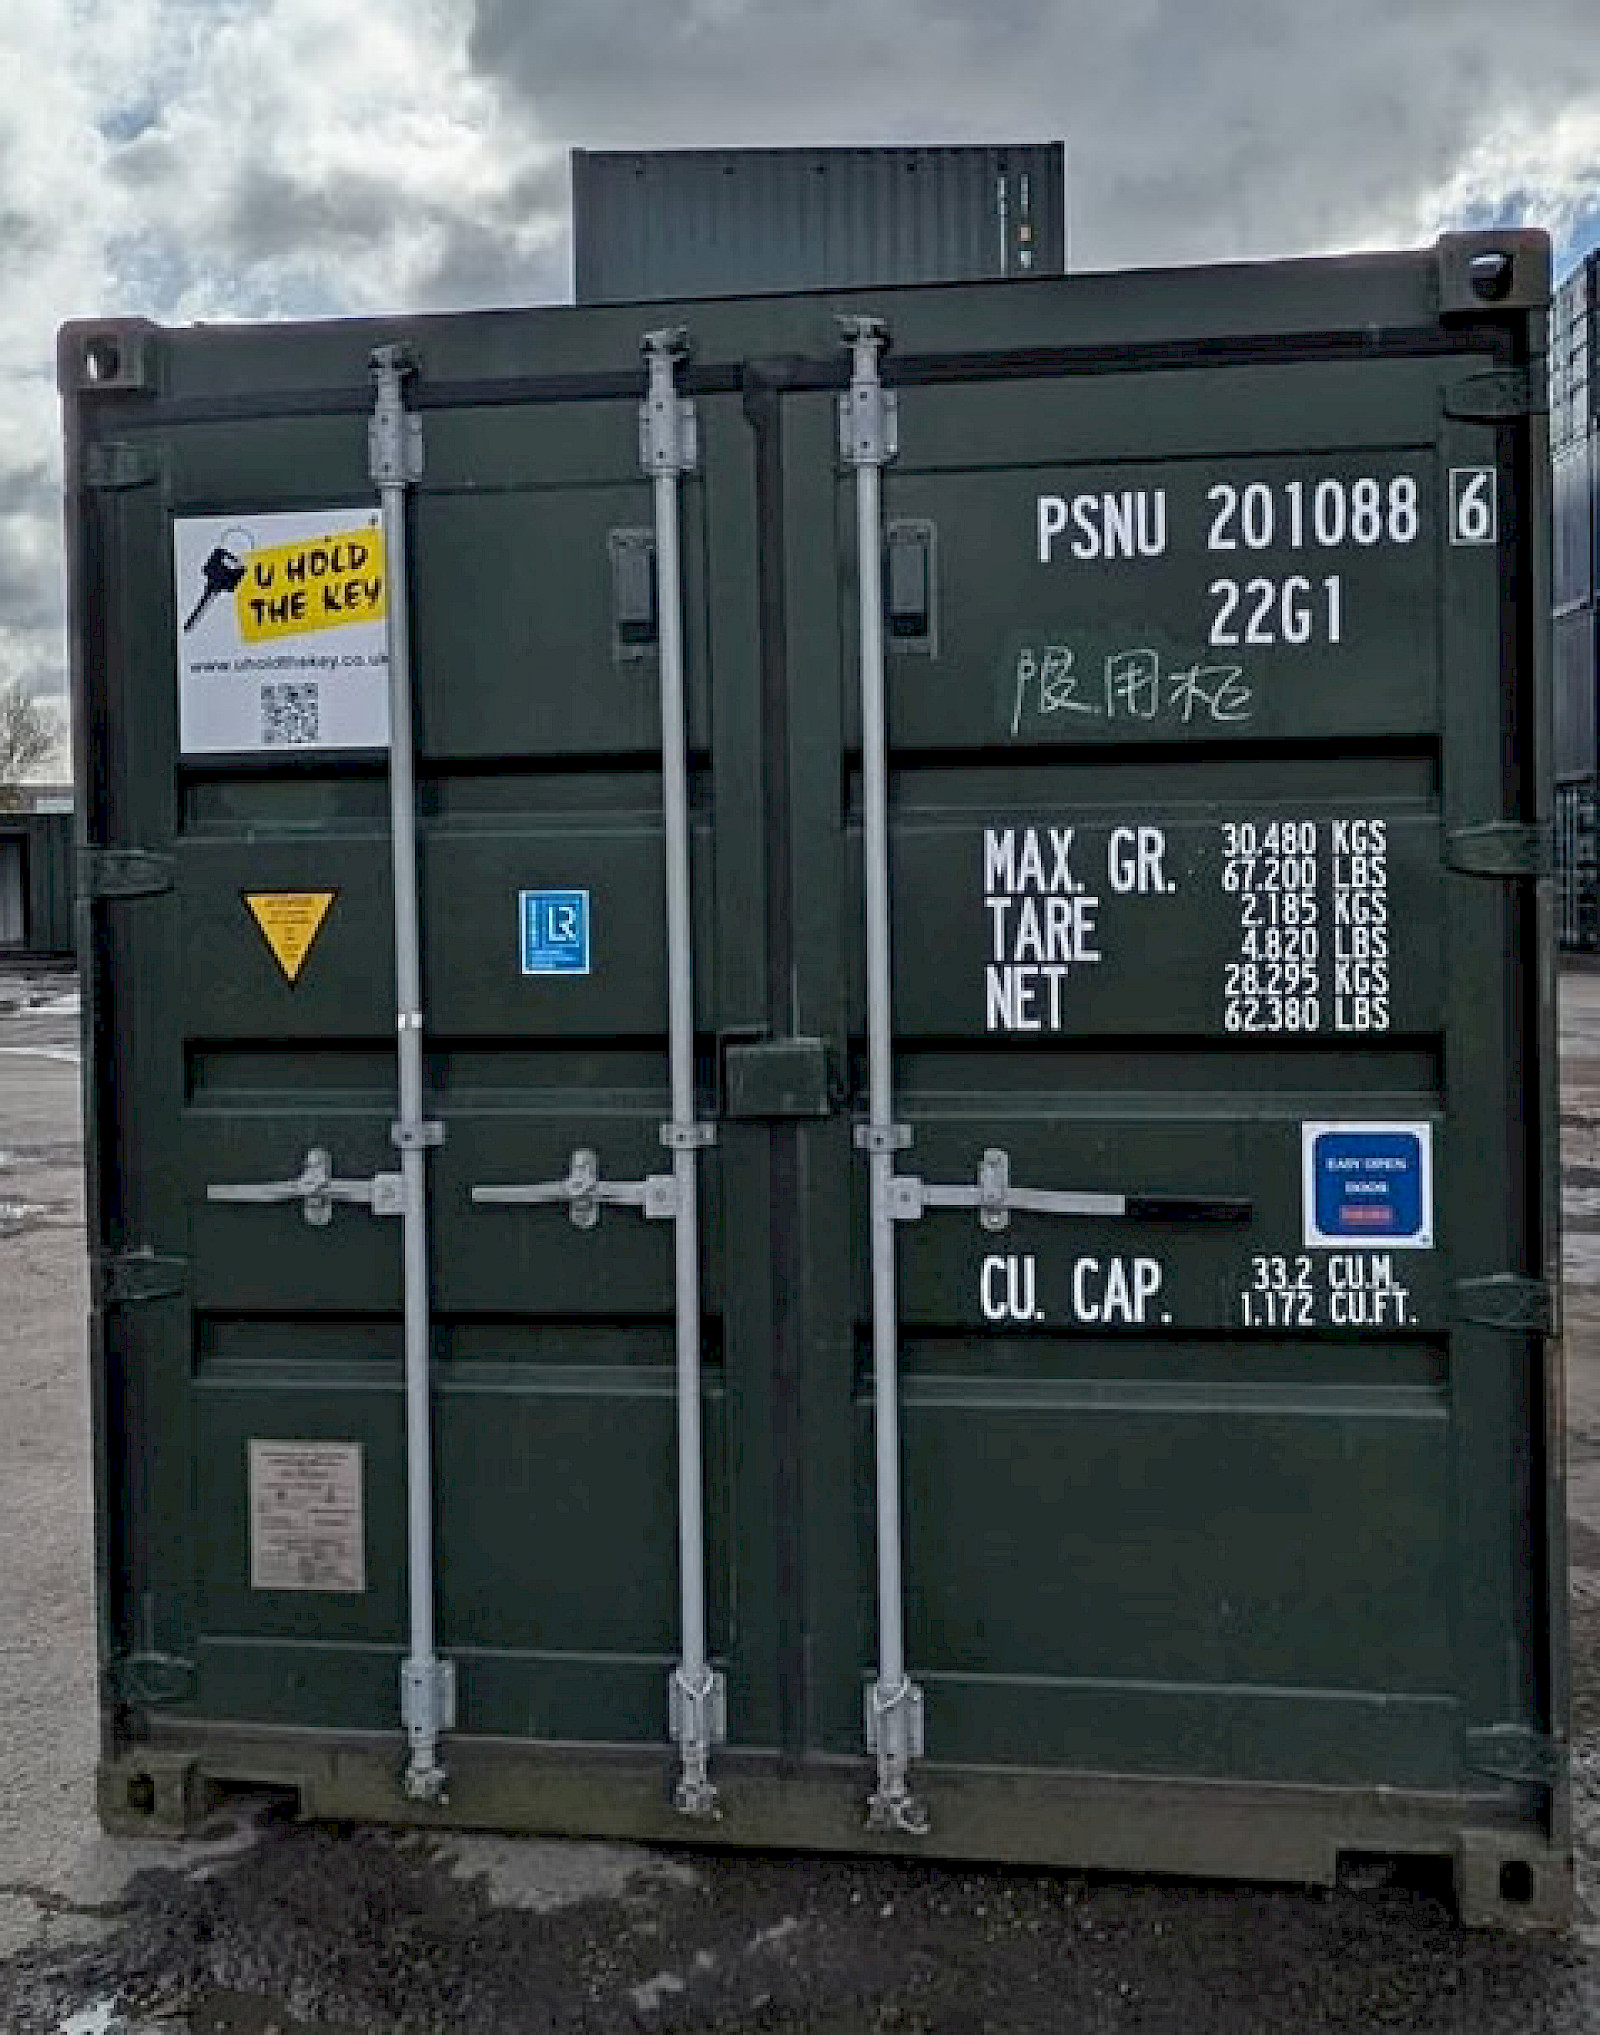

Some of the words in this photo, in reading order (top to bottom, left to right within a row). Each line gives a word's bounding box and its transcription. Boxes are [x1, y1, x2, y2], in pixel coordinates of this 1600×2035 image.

[1038, 489, 1165, 562] PSNU
[1208, 475, 1419, 549] 201088
[1459, 473, 1488, 538] 6
[254, 562, 275, 590] U
[287, 542, 369, 582] HOLD
[248, 592, 306, 627] THE
[323, 576, 382, 610] KEY
[1209, 575, 1339, 646] 22G1
[984, 828, 1085, 893] MAX.
[1108, 826, 1175, 893] GR.
[1221, 820, 1317, 857] 30.480
[1331, 820, 1388, 855] KGS
[1221, 856, 1317, 891] 67.200
[1331, 856, 1388, 889] LBS
[984, 897, 1100, 961] TARE
[1241, 893, 1318, 926] 2.185
[1334, 890, 1388, 924] KGS
[1241, 927, 1319, 959] 4.820
[1334, 926, 1388, 958] LBS
[987, 964, 1067, 1030] NET
[1224, 964, 1319, 995] 28.295
[1334, 964, 1389, 995] KGS
[1224, 999, 1319, 1031] 62.380
[1334, 998, 1389, 1031] LBS
[981, 1255, 1044, 1319] CU.
[1074, 1258, 1172, 1322] CAP.
[1252, 1257, 1312, 1290] 33.2
[1241, 1292, 1314, 1326] 1.172
[1330, 1291, 1417, 1324] CU.FT.
